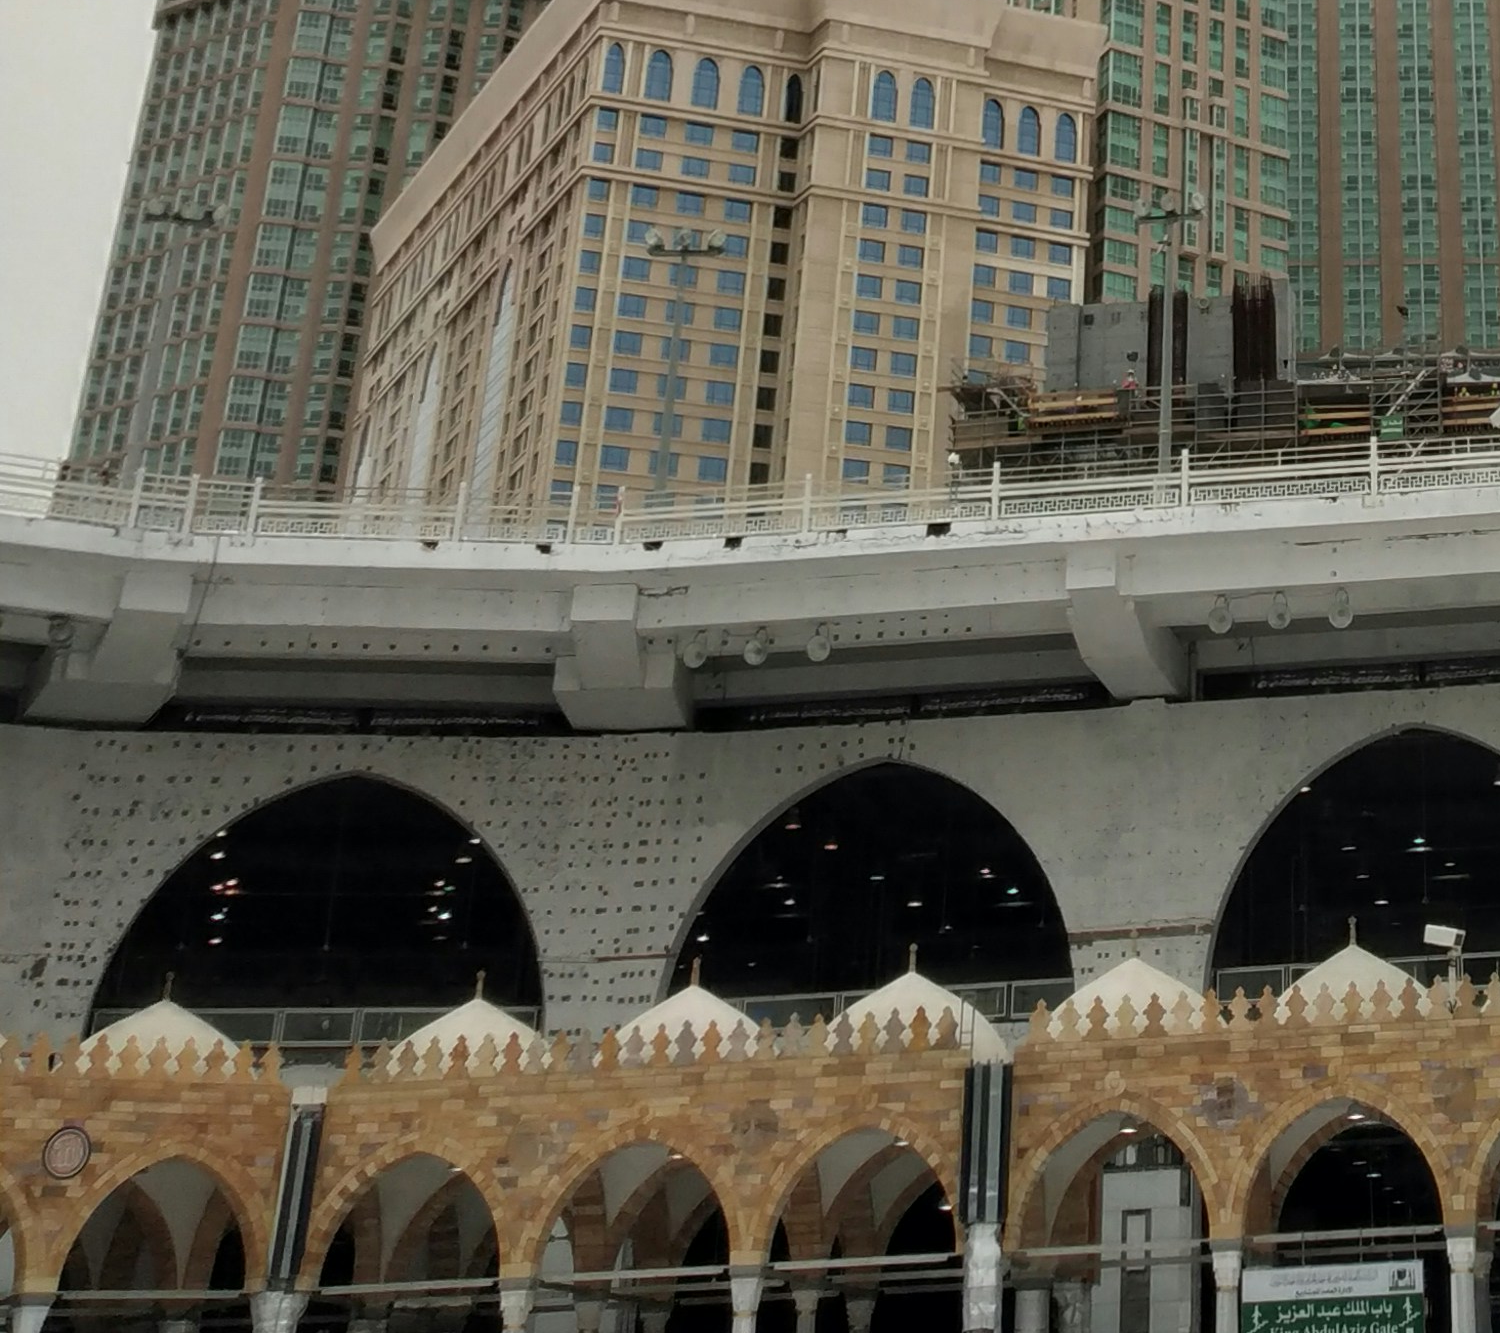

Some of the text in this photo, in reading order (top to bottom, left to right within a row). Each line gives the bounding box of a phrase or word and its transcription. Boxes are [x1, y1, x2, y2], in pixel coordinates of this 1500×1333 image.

[1275, 1299, 1393, 1323] باب الملك عبد العزيز
[1369, 1321, 1399, 1333] Gate
